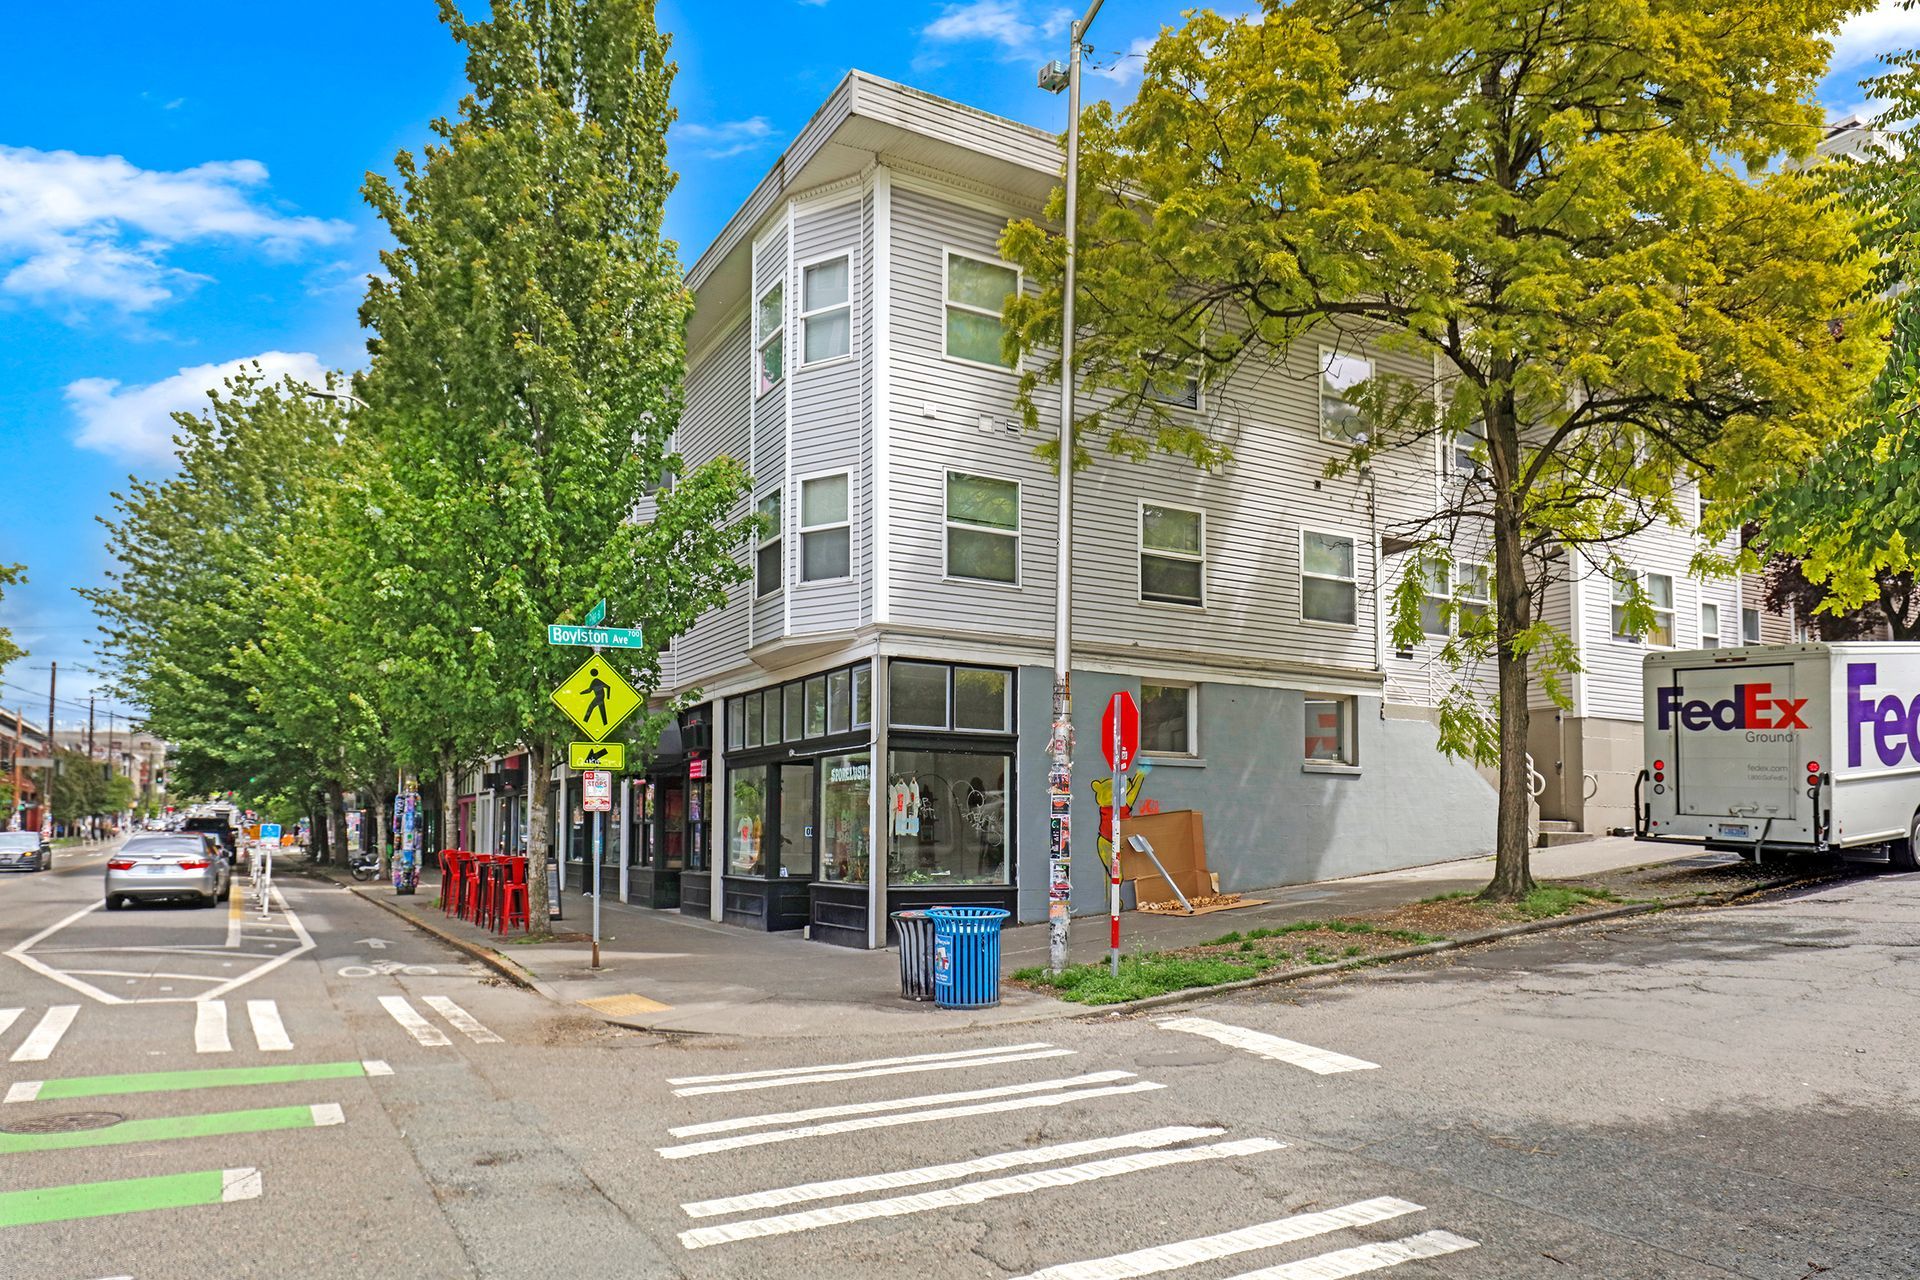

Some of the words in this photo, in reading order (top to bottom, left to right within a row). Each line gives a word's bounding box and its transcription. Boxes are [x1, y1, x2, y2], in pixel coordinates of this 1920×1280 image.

[553, 627, 608, 645] Boylston
[613, 635, 628, 645] Ave
[628, 630, 640, 638] 700
[1657, 683, 1809, 731] FedEx
[1745, 730, 1794, 743] Ground
